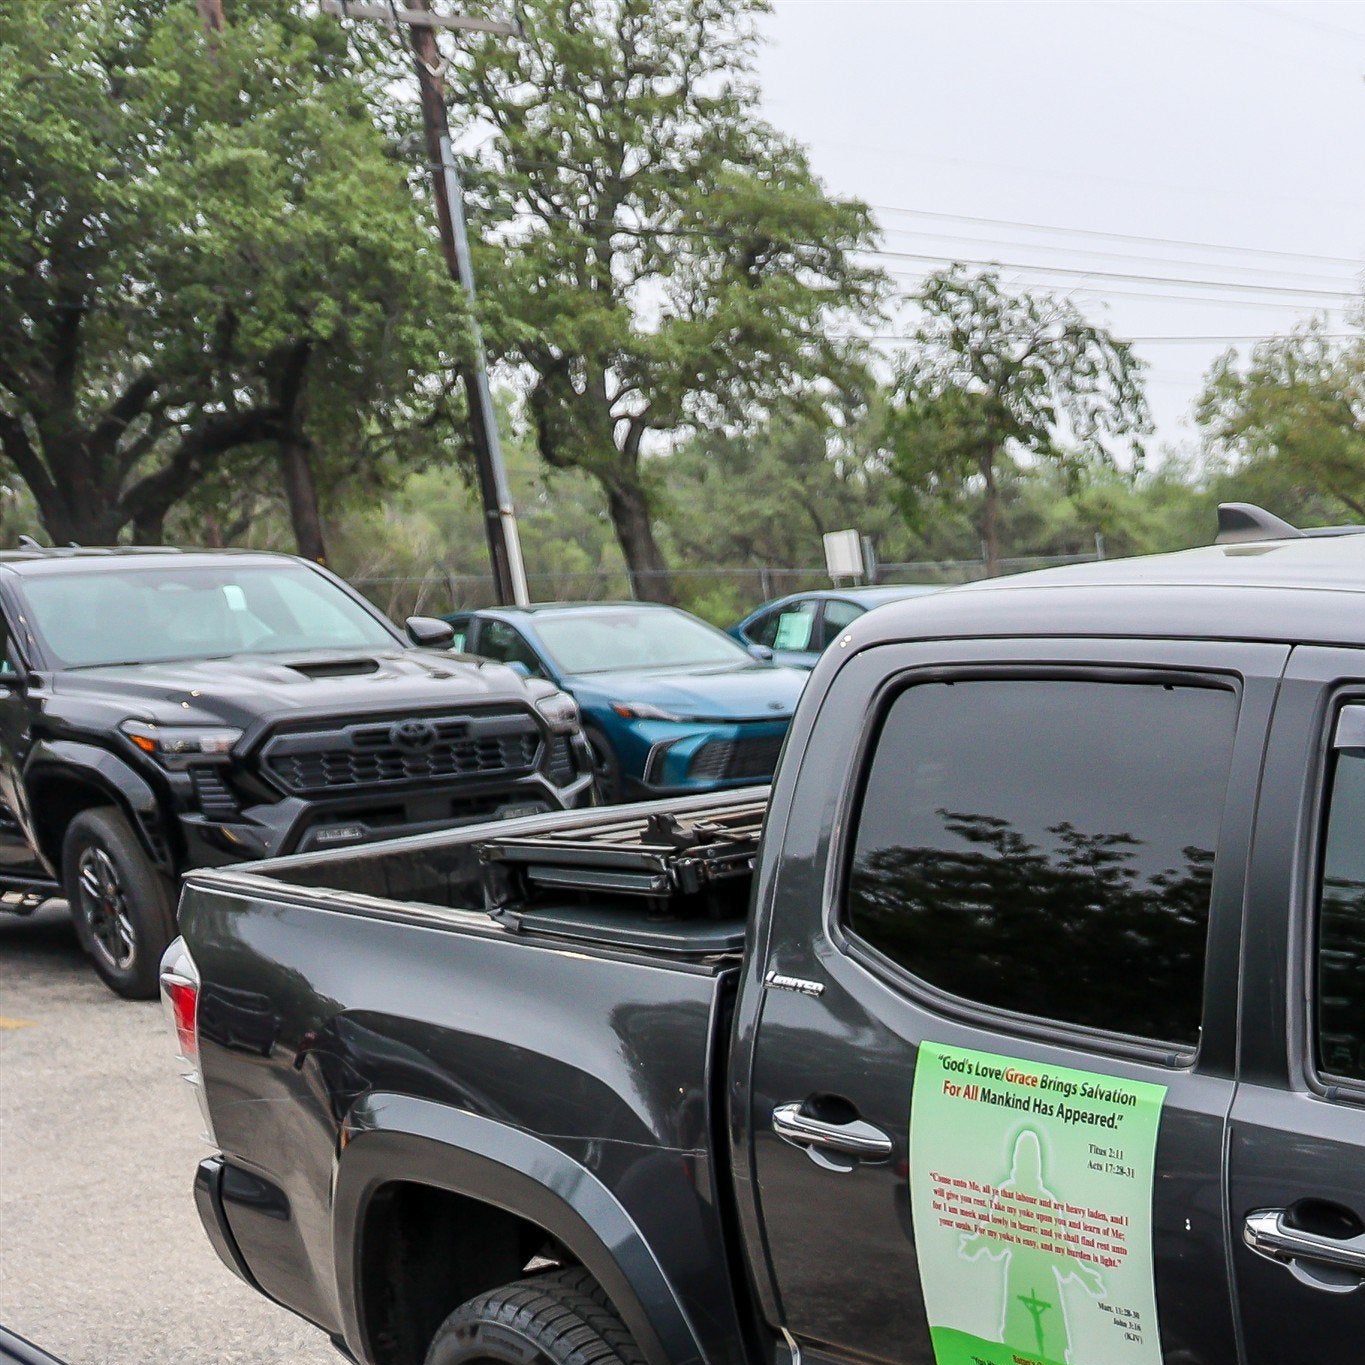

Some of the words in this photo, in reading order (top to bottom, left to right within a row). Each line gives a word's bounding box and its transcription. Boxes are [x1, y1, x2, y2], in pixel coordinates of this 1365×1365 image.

[975, 1062, 1038, 1087] Love/Grace
[1039, 1074, 1077, 1098] Brings
[1079, 1082, 1136, 1106] Salvation
[943, 1079, 960, 1097] For
[962, 1084, 979, 1101] All
[979, 1087, 1029, 1111] Mankind
[1032, 1097, 1054, 1116] Has
[1056, 1103, 1123, 1129] Appeared."
[1088, 1143, 1105, 1156] Titus
[1087, 1159, 1102, 1171] Acts
